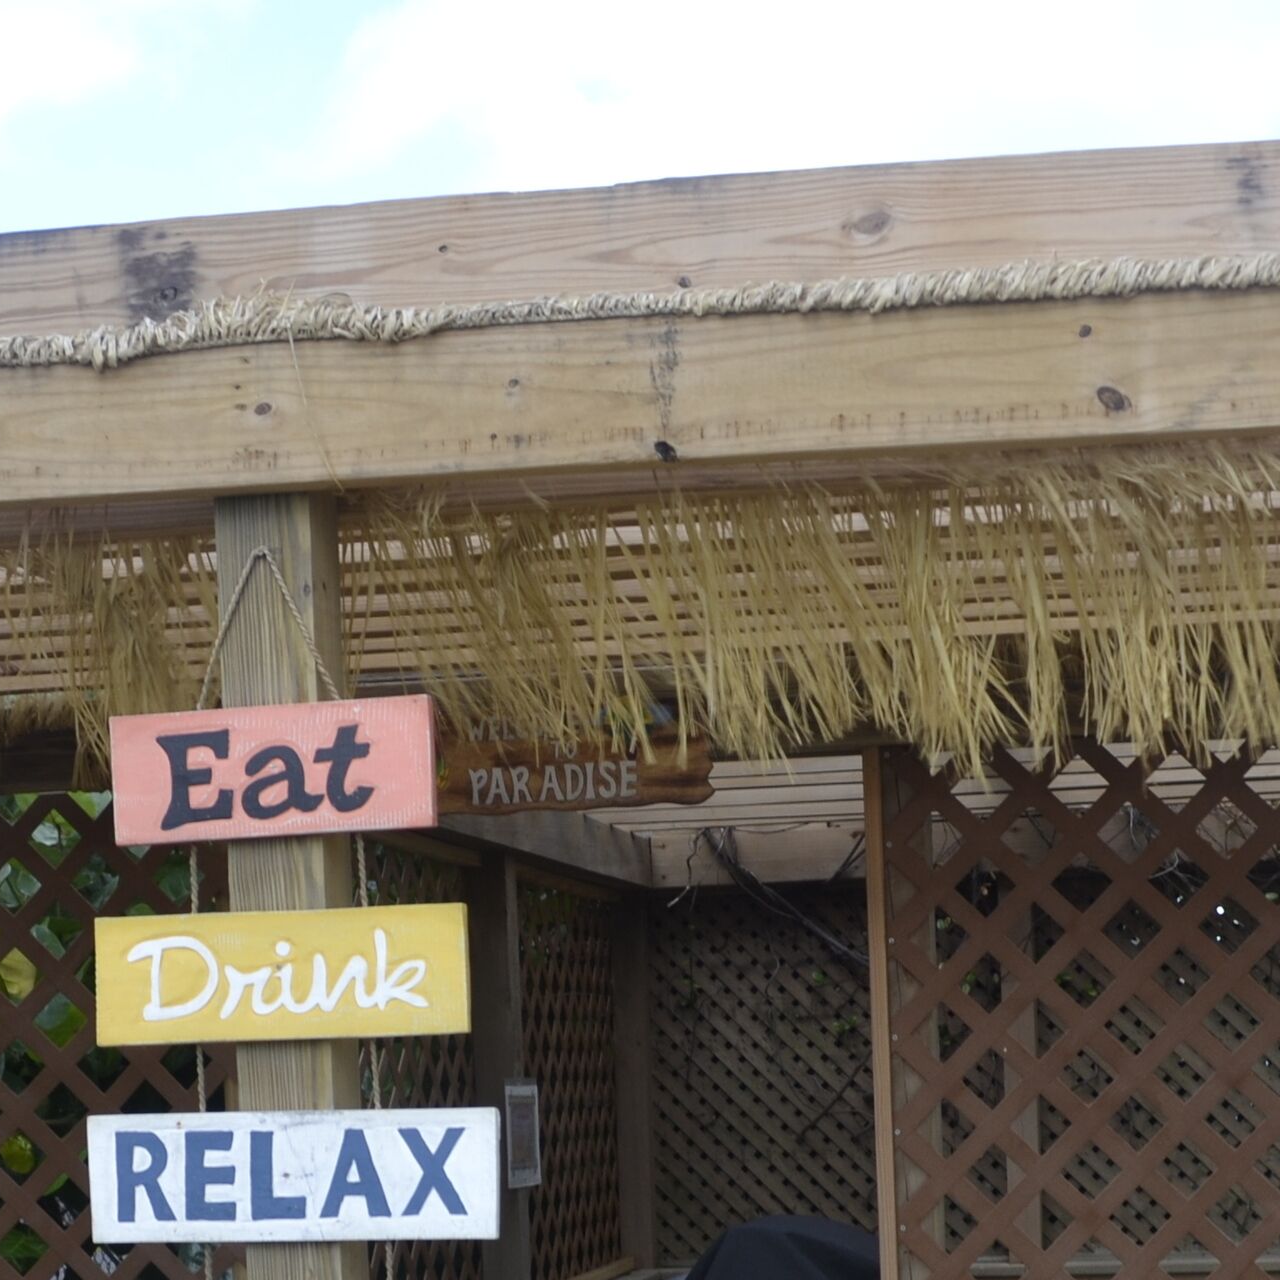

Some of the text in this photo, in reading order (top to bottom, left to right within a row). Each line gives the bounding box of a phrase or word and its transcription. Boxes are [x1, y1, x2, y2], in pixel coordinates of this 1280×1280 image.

[155, 724, 375, 831] Eat
[468, 760, 638, 806] PARADISE
[126, 929, 429, 1022] Drink
[114, 1127, 468, 1222] RELAX
